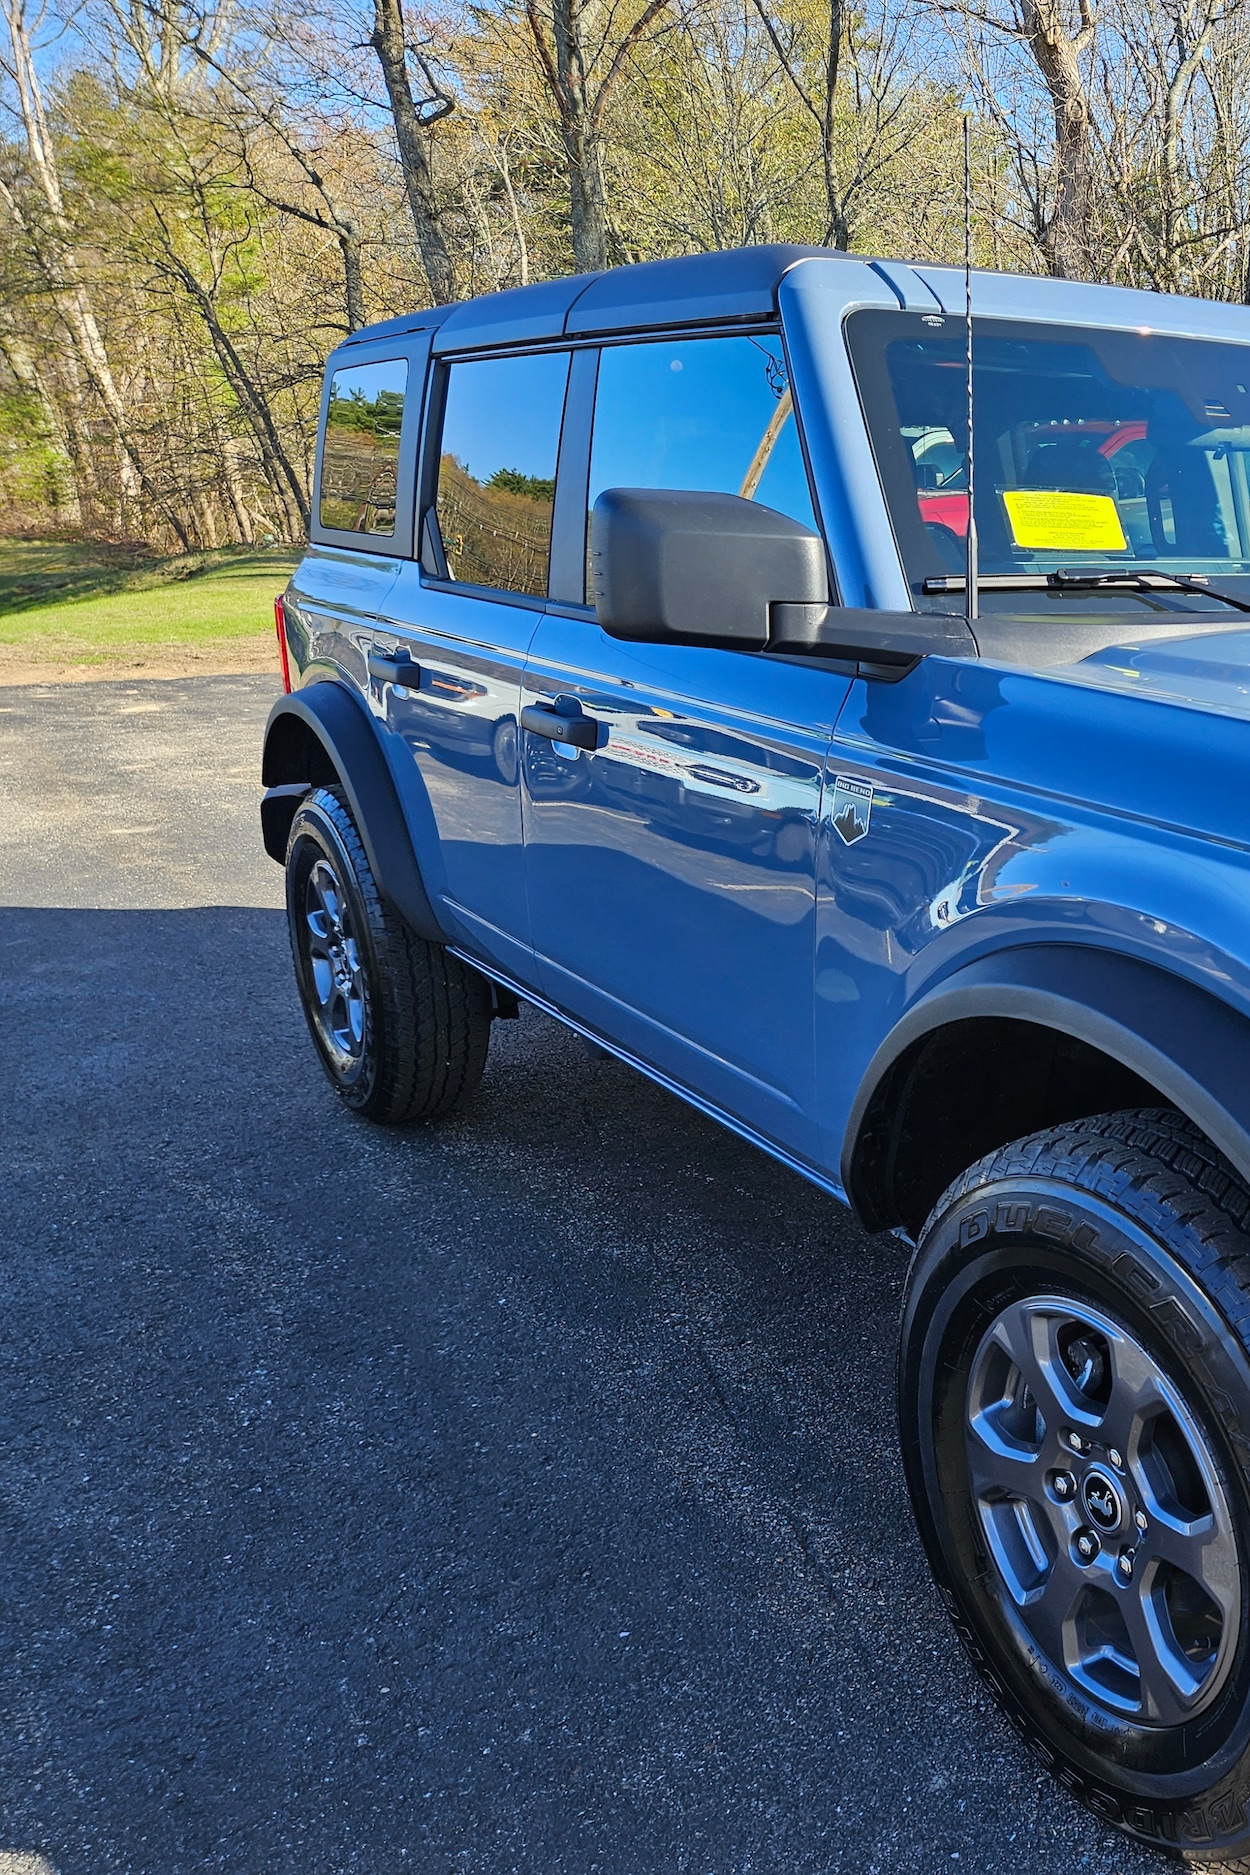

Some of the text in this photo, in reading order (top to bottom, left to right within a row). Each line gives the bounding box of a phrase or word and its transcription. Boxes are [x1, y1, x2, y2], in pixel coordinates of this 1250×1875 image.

[837, 780, 871, 797] BIG BEND
[959, 1200, 1208, 1358] DUELER
